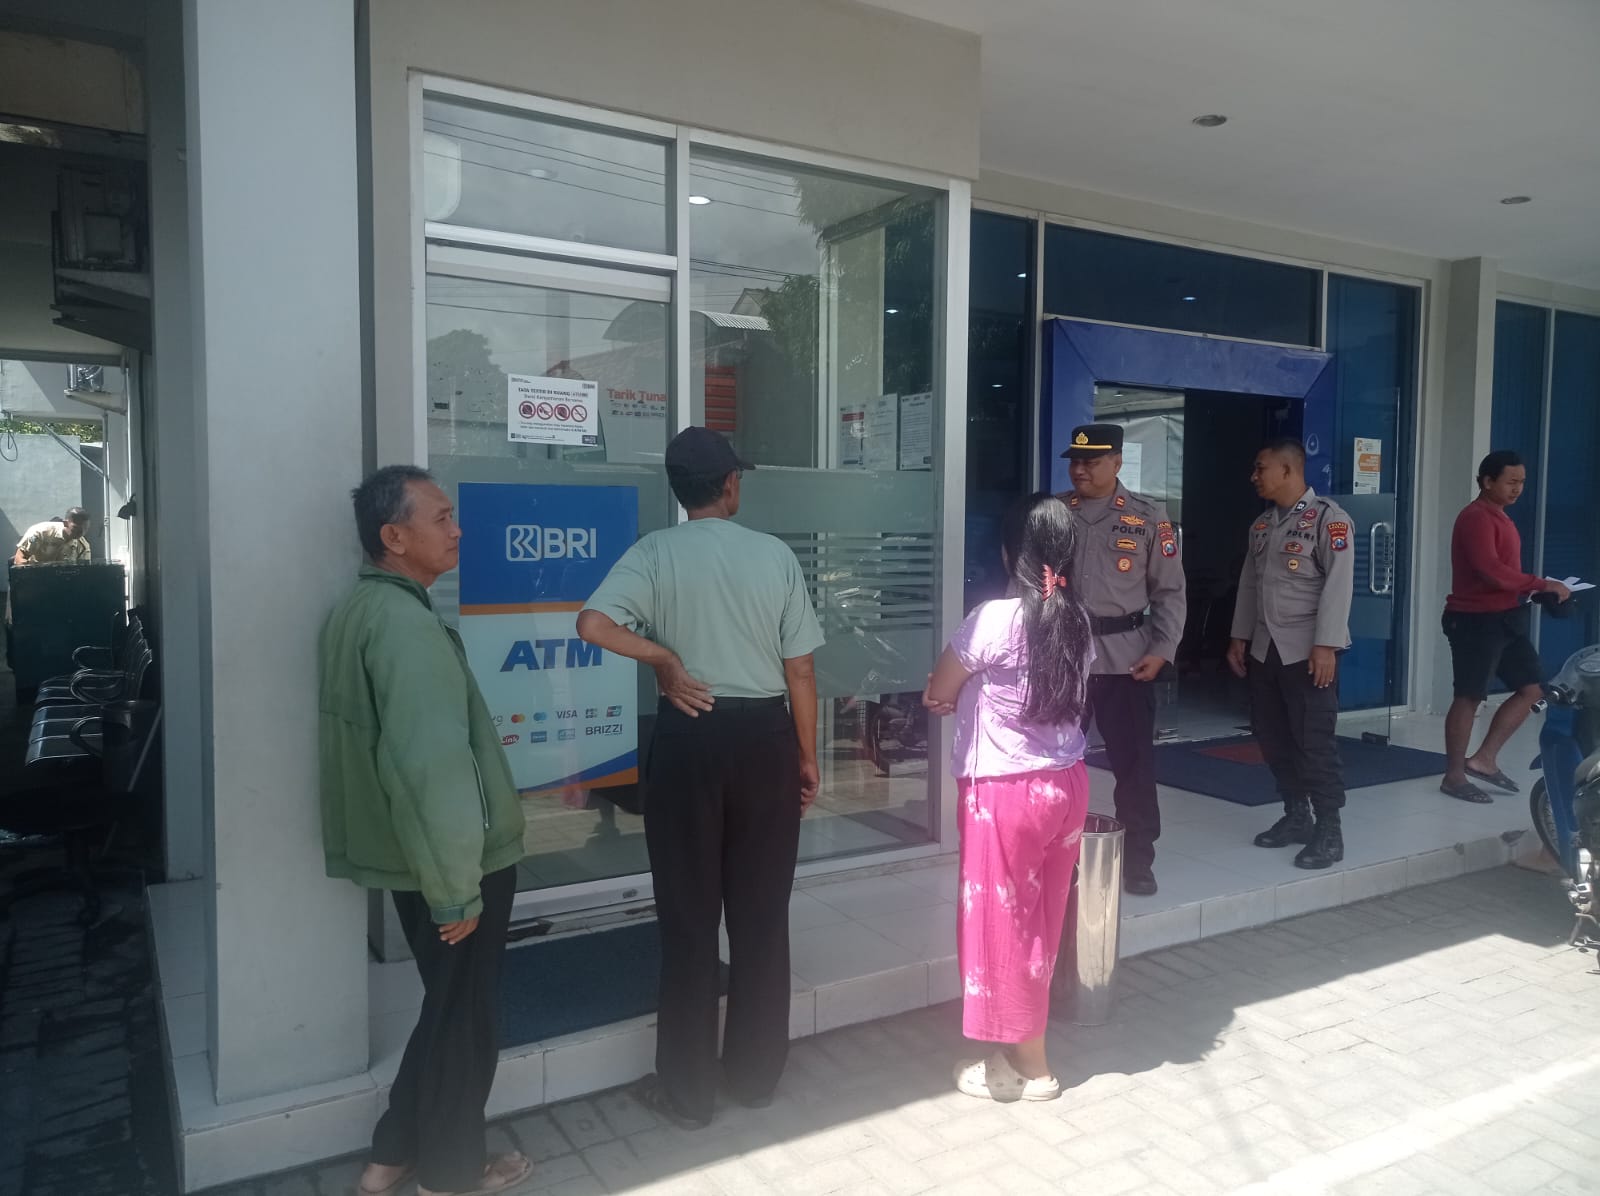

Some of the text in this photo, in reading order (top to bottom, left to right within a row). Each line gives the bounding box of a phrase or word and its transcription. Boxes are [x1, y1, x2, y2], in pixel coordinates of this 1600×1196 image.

[607, 388, 636, 400] Tarik
[1111, 524, 1146, 537] POLRI
[543, 527, 597, 559] BRI
[500, 637, 603, 672] ATM
[556, 709, 578, 720] VISA
[585, 723, 623, 736] BRIZZI
